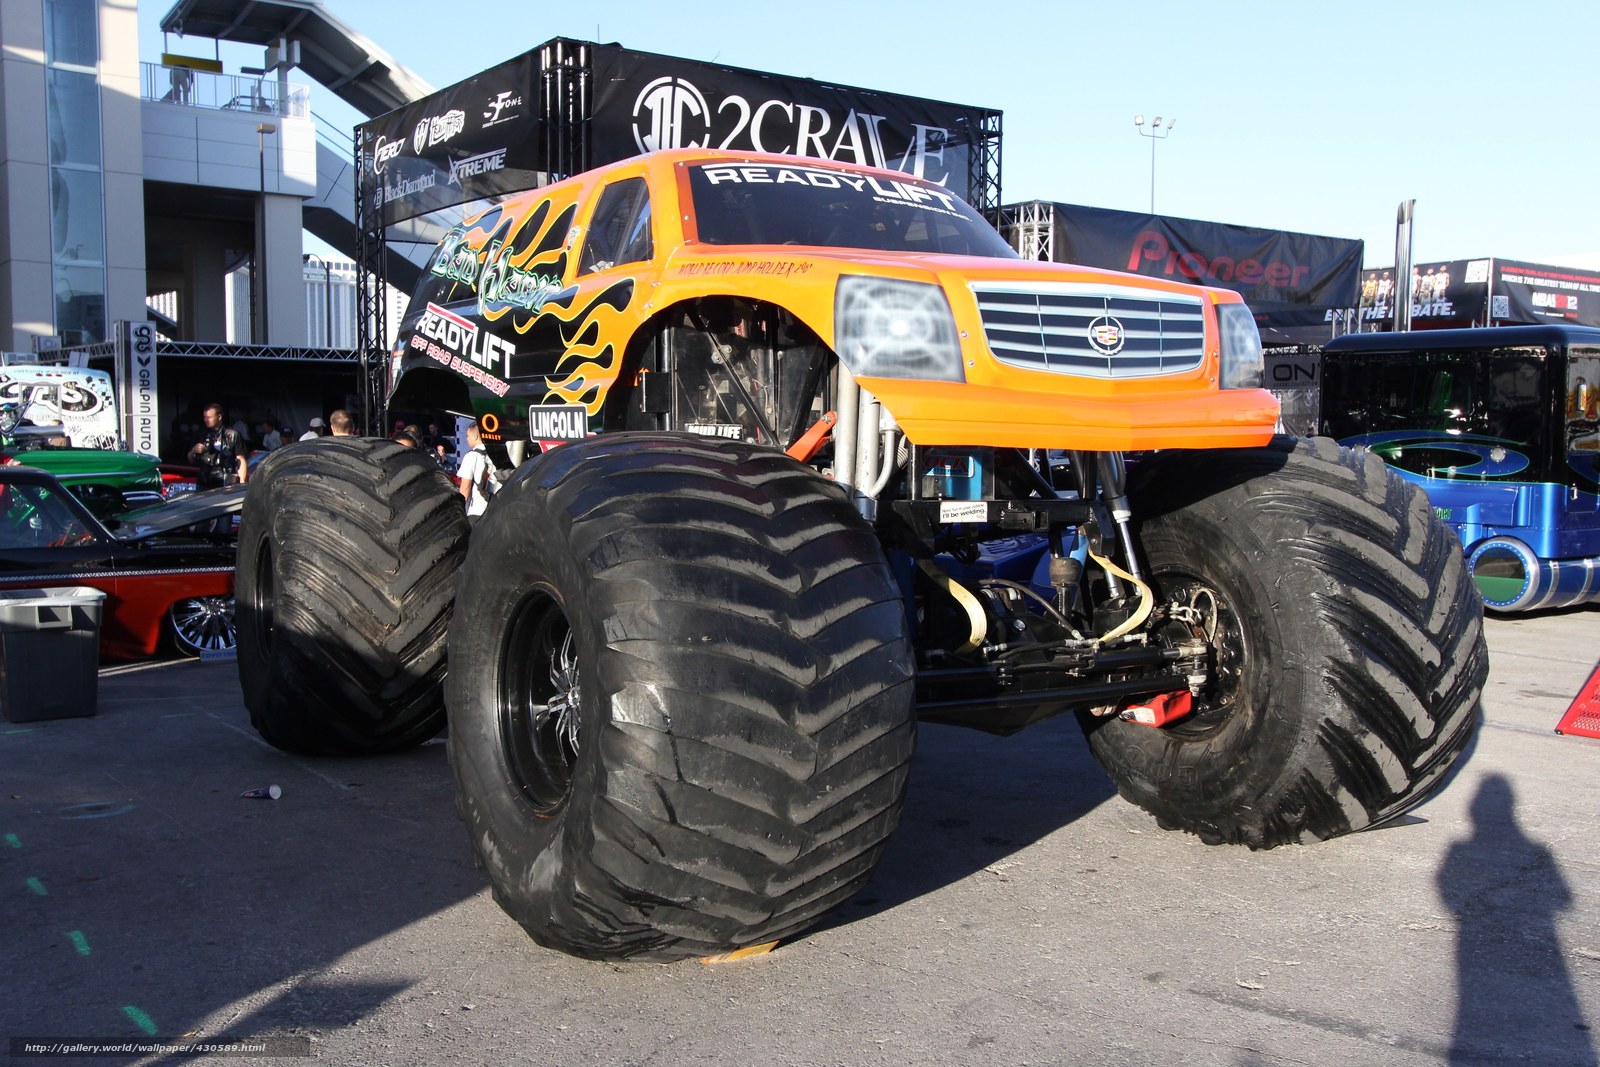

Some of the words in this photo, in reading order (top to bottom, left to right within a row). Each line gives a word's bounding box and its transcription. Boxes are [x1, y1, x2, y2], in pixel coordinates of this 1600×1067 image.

[447, 153, 507, 189] XTREME
[704, 168, 956, 211] READYLIFT
[872, 197, 951, 216] SUSPENSION
[679, 262, 704, 277] WORLD
[704, 261, 735, 276] RECORD
[758, 261, 795, 278] HOLDER
[1127, 231, 1310, 287] Pioneer
[1535, 278, 1559, 289] GREATEST
[1360, 306, 1387, 320] THE
[415, 311, 516, 379] READYLIFT
[410, 335, 428, 351] OFF
[426, 342, 451, 366] ROAD
[450, 356, 511, 398] SUSPENSION
[1273, 363, 1320, 381] ON
[139, 369, 151, 413] GALPIN
[140, 418, 152, 450] AUTO
[532, 411, 585, 439] LINCOLN
[717, 426, 741, 440] LIFE
